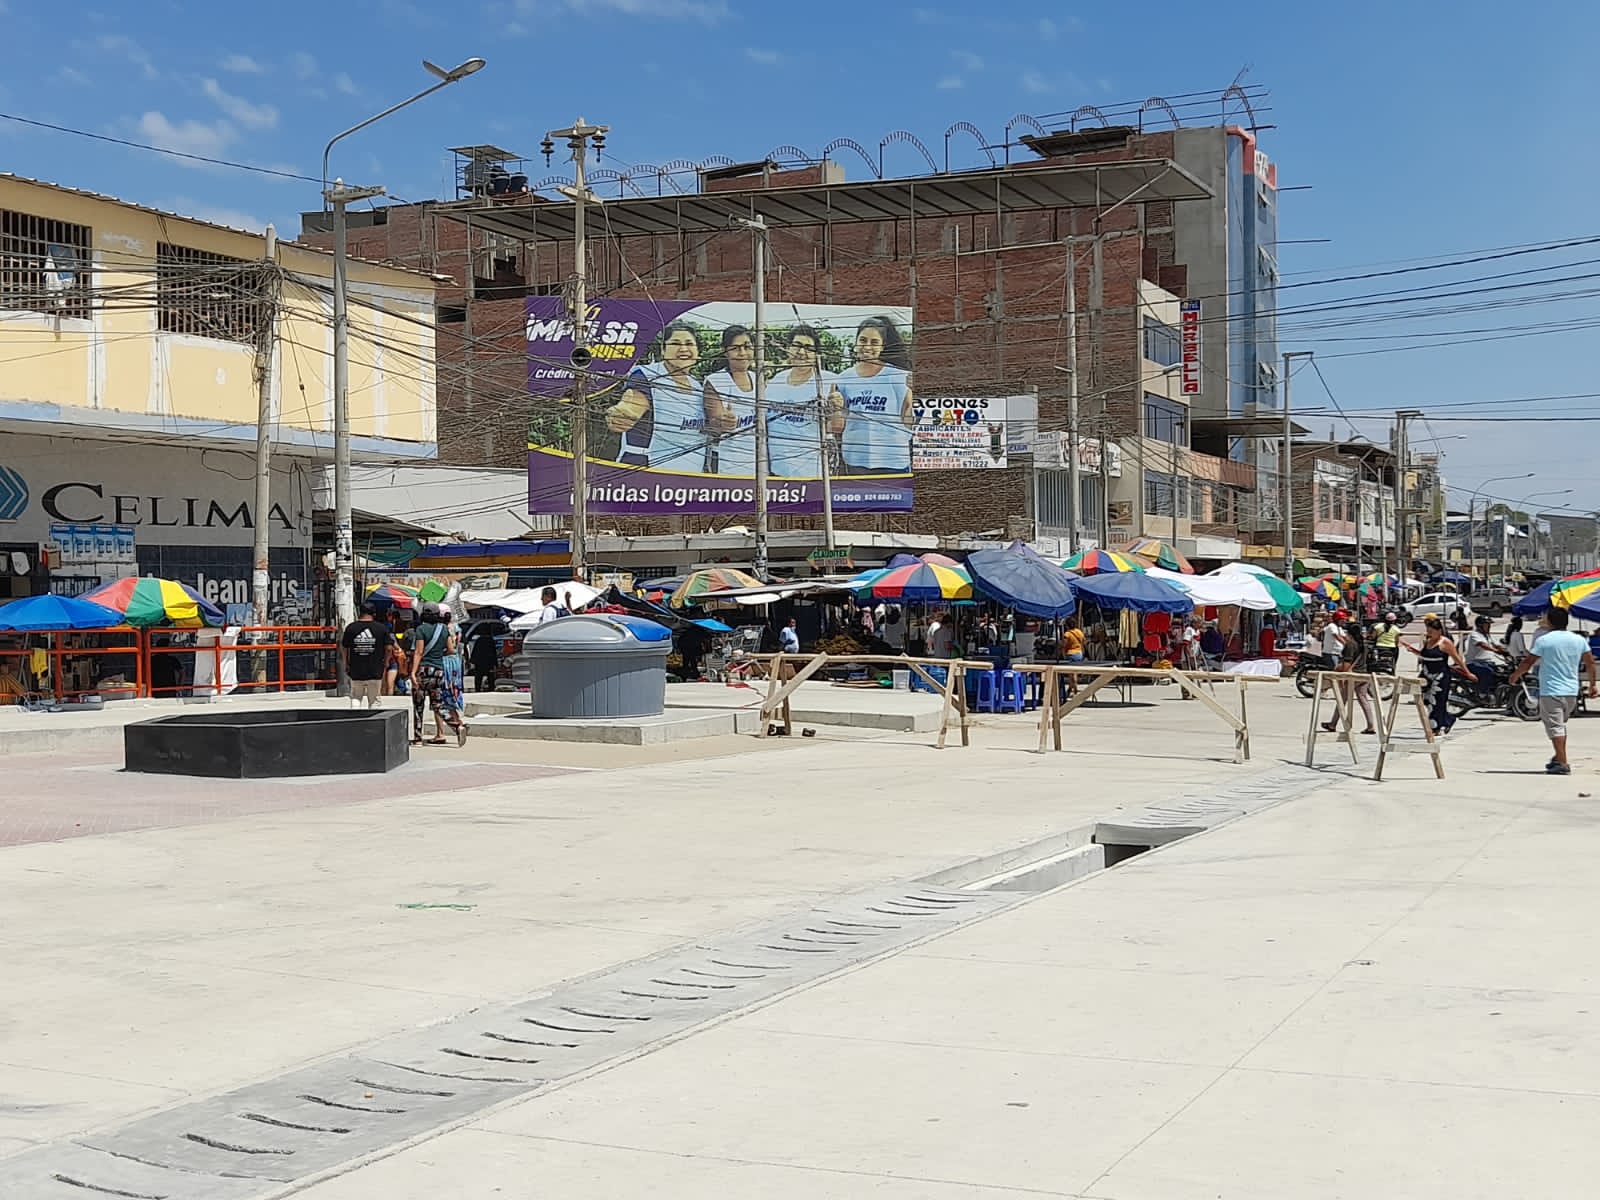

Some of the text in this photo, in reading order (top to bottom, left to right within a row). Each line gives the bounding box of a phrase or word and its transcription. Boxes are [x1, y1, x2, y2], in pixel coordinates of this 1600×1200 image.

[931, 408, 979, 425] SATO
[41, 482, 297, 529] CELIMA
[654, 483, 754, 506] logramos
